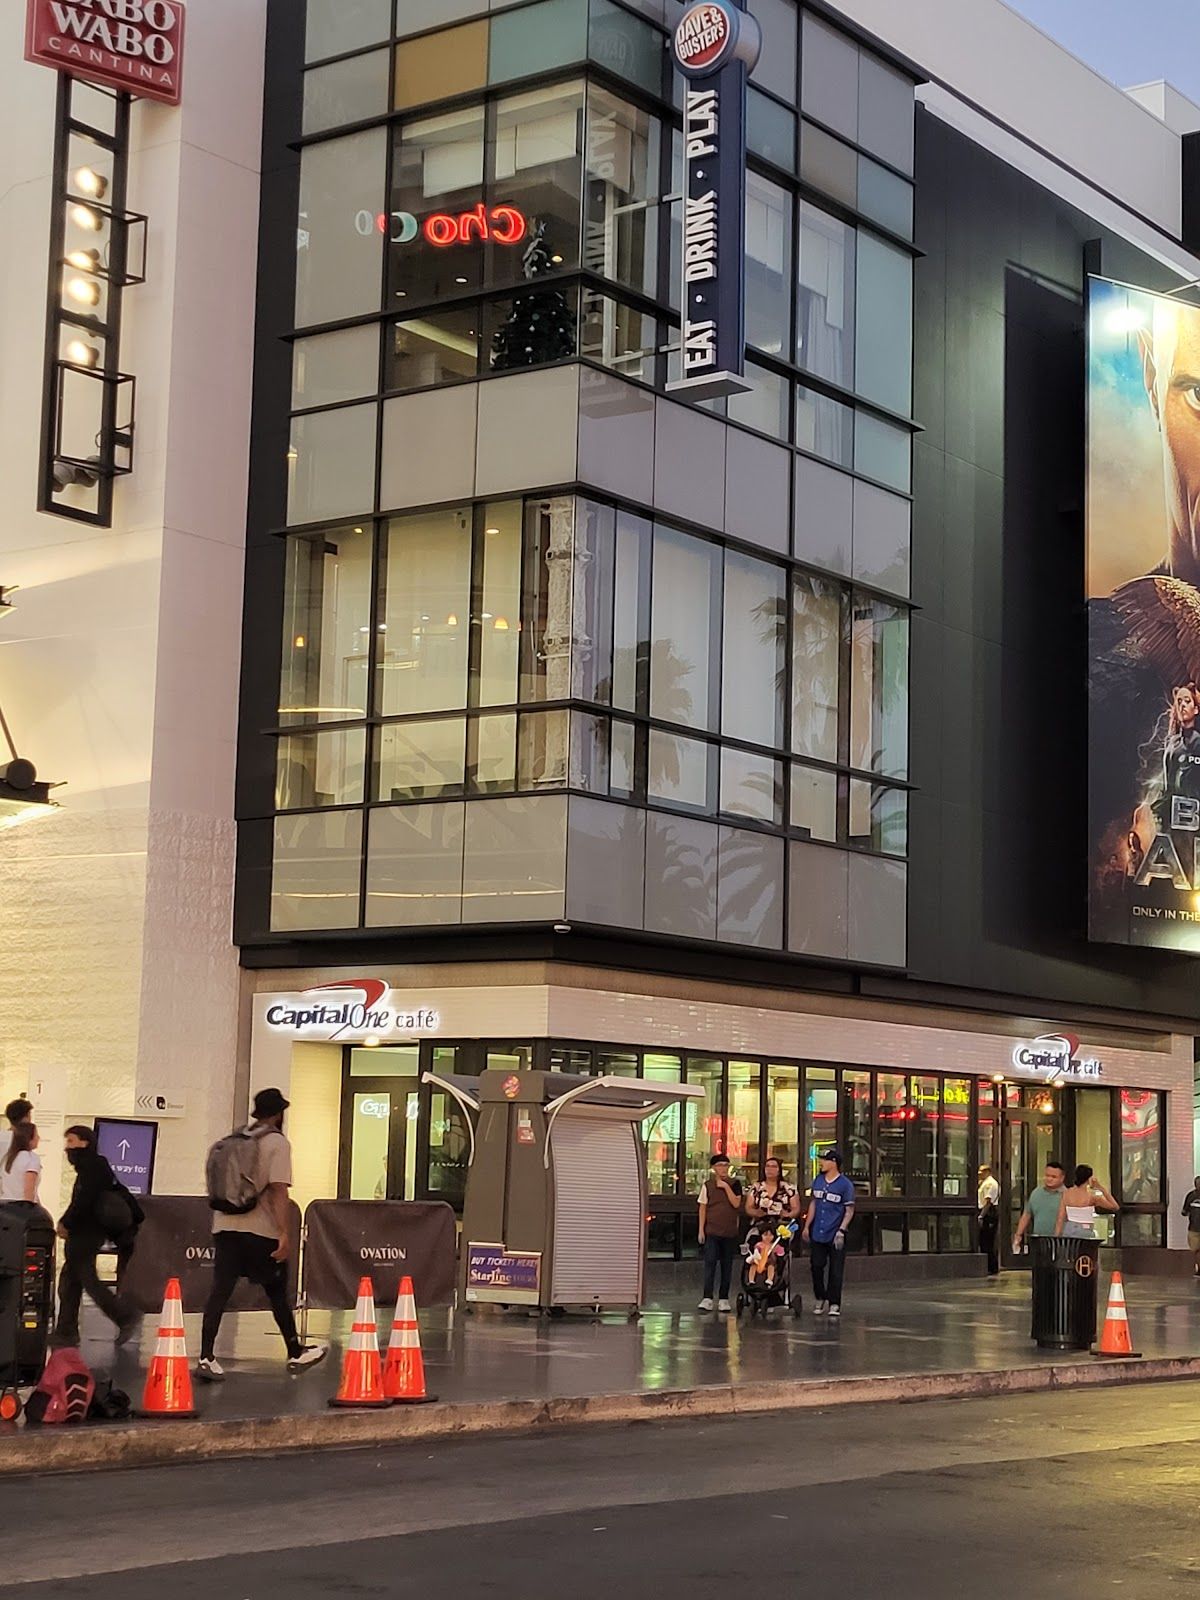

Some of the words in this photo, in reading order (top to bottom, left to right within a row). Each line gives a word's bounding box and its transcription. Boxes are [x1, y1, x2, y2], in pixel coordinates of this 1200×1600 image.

[50, 2, 175, 64] WABO
[70, 0, 176, 31] ABO
[48, 37, 173, 86] CANTINA
[678, 21, 725, 60] BUSTER'S
[686, 90, 719, 159] PLAY
[685, 190, 718, 283] DRINK
[684, 319, 717, 370] EAT
[1133, 833, 1200, 891] A
[1132, 906, 1161, 918] ONLY
[1164, 909, 1176, 920] IN
[1179, 910, 1200, 922] THE
[396, 1010, 434, 1028] café
[361, 1244, 406, 1260] OVATION
[471, 1256, 485, 1266] BUY
